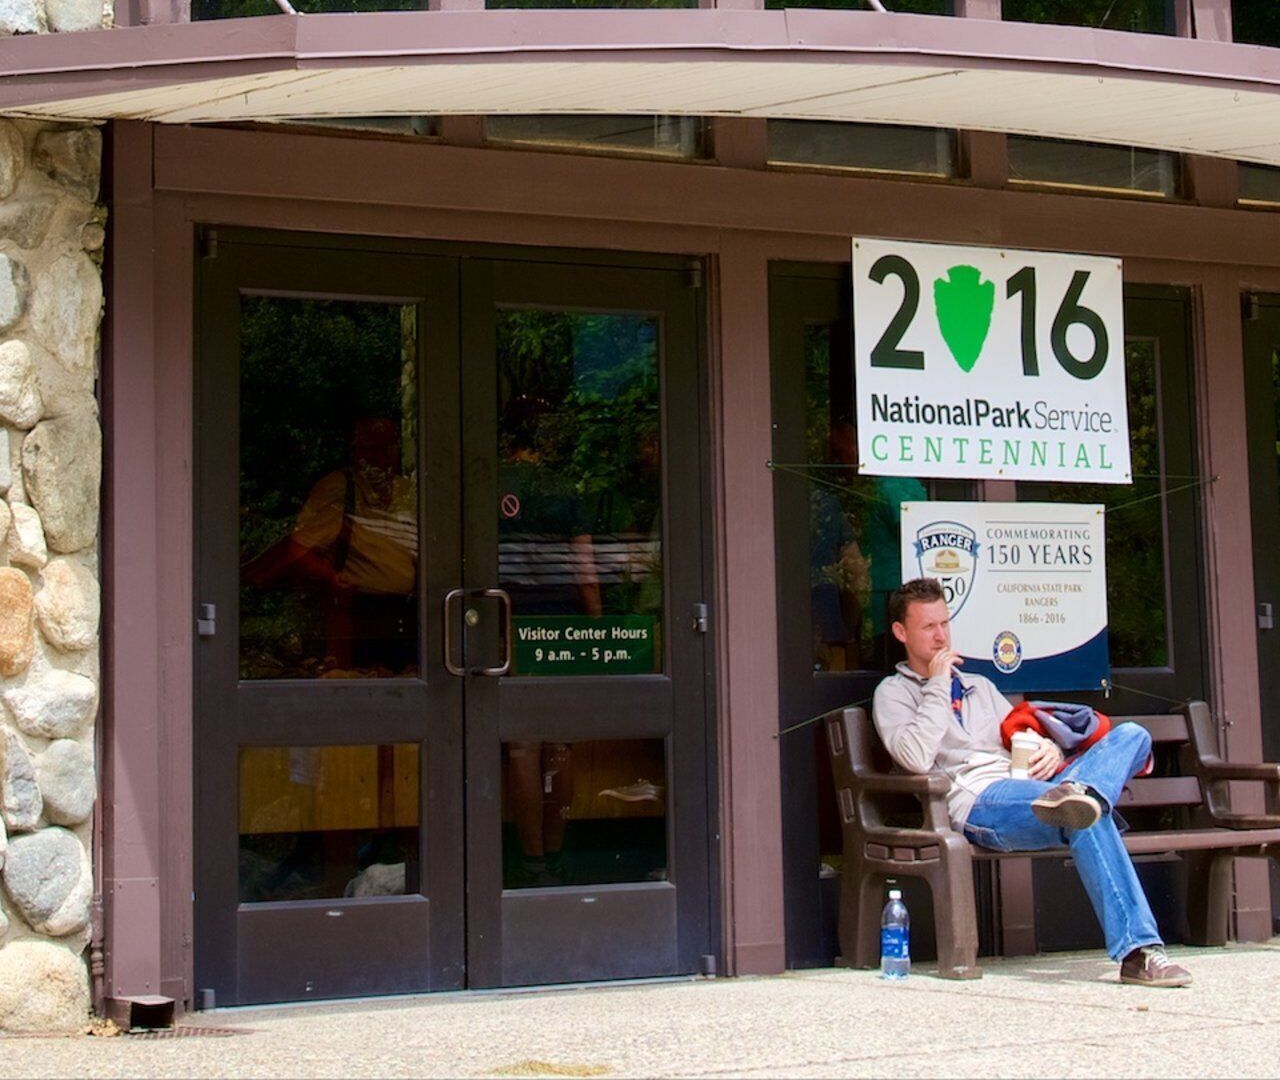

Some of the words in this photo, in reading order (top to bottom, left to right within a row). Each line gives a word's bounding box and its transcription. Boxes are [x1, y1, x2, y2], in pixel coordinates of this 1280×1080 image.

[871, 434, 1113, 469] CENTENNIAL
[986, 528, 1090, 540] COMMEMORATING
[921, 534, 972, 550] RANGER
[987, 544, 1020, 565] 150
[1028, 545, 1093, 565] YEARS
[997, 583, 1040, 593] CALIFORNIA
[1042, 584, 1062, 593] STATE
[1064, 584, 1082, 593] PARK
[1024, 597, 1058, 607] RANGERS
[518, 627, 561, 640] Visitor
[565, 627, 607, 640] Center
[611, 627, 648, 639] Hours
[535, 648, 543, 661] 9
[548, 650, 575, 661] a.m.
[591, 648, 600, 660] 5
[604, 650, 631, 663] p.m.
